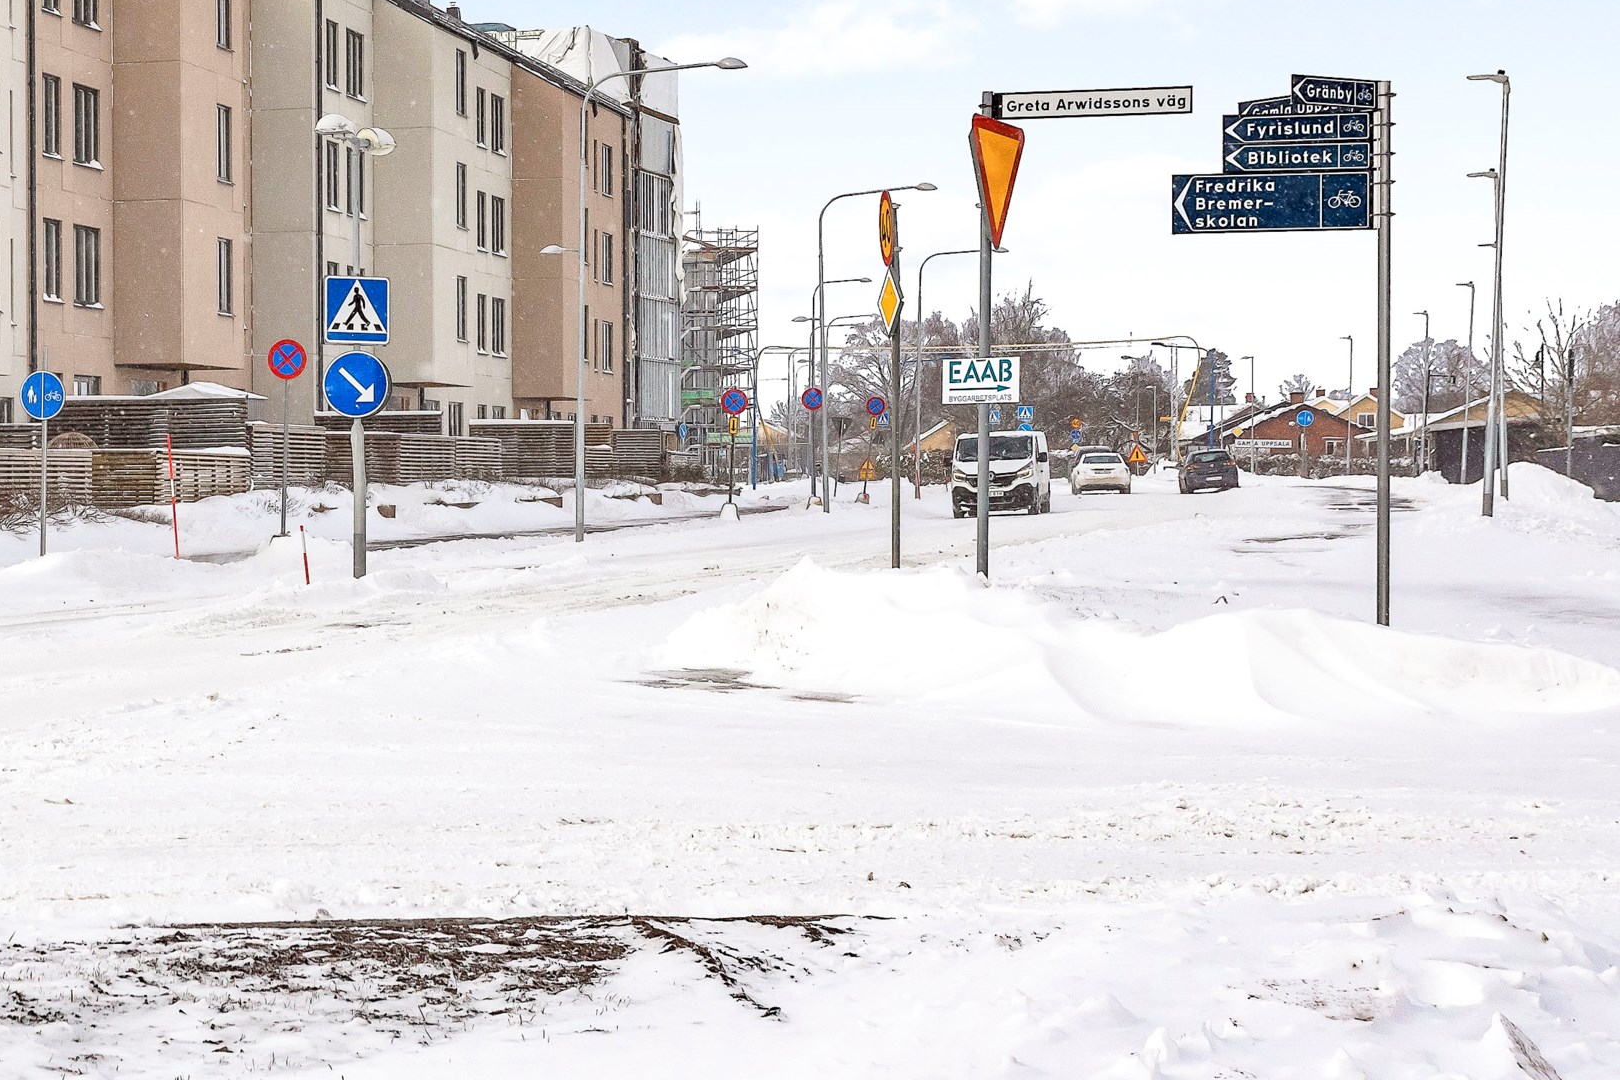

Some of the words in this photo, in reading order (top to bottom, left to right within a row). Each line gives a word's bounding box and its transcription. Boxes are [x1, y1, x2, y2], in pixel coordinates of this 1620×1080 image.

[1306, 83, 1353, 103] Gränby
[1006, 99, 1050, 112] Greta
[1056, 96, 1150, 111] Arwidssons
[1157, 94, 1187, 110] väg
[1246, 120, 1334, 139] Fyrislund
[1247, 150, 1333, 166] Bibliotek
[1195, 178, 1275, 193] Fredrika
[1195, 197, 1274, 210] Bremer-
[1195, 214, 1258, 228] skolan
[949, 359, 1013, 384] EAAB
[948, 393, 1013, 403] BYGGARBETSPLATS
